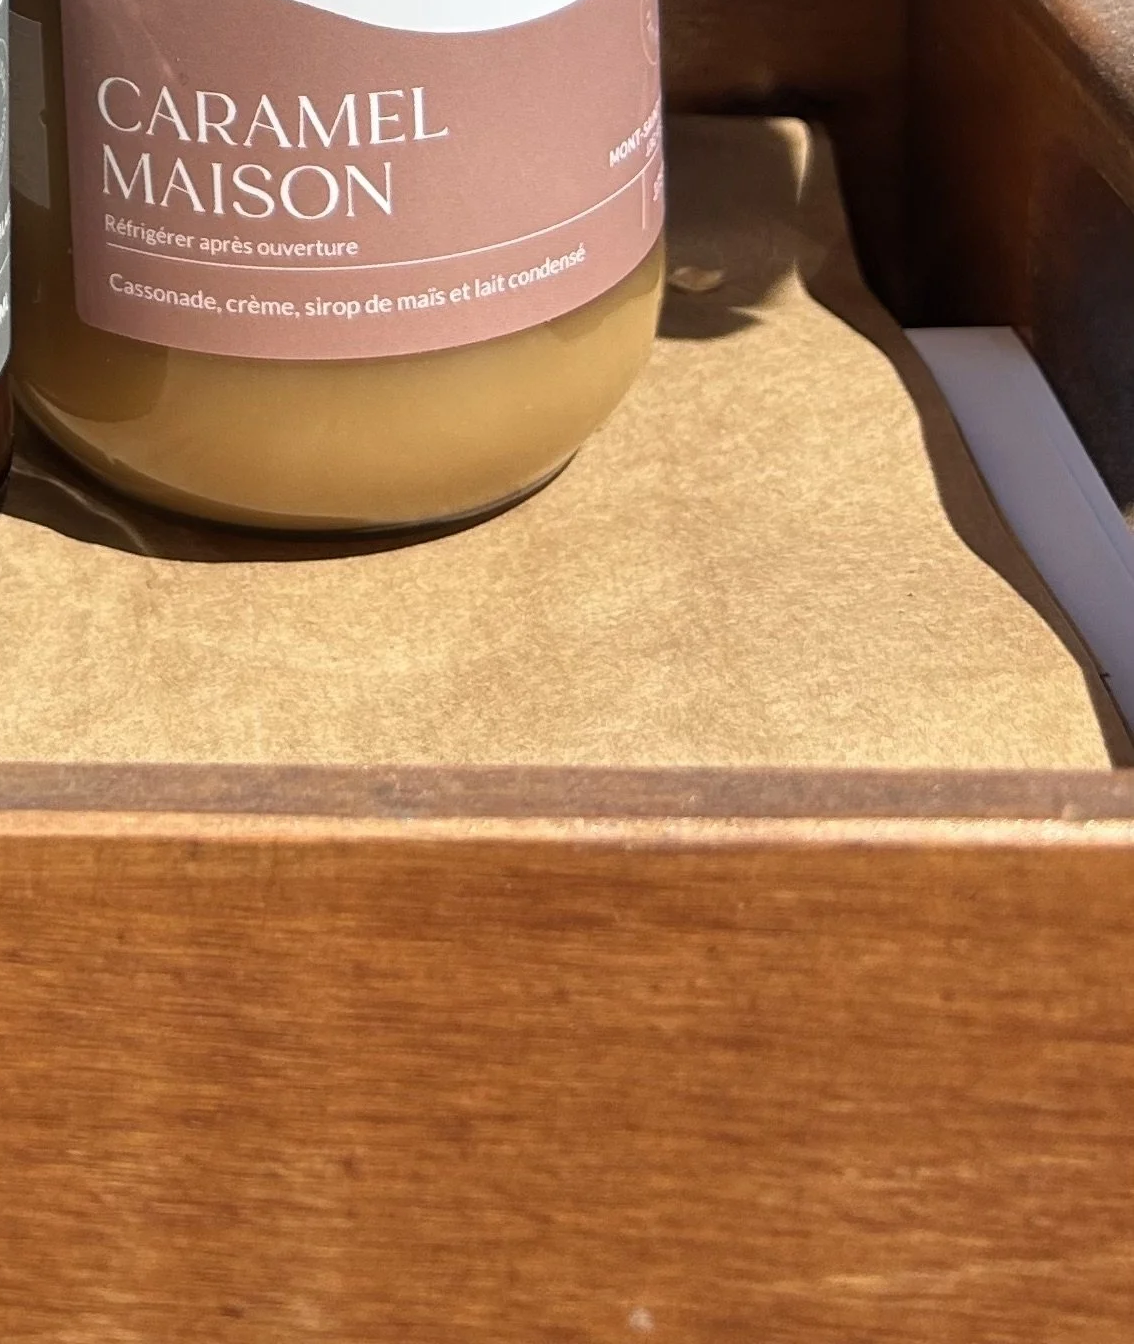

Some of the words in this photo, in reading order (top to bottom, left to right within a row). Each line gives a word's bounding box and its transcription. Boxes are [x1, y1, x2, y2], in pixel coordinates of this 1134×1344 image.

[97, 76, 450, 149] CARAMEL
[102, 143, 393, 220] MAISON
[104, 214, 195, 248] Réfrigérer
[199, 236, 253, 256] après
[257, 239, 359, 257] ouverture
[109, 272, 223, 314] Cassonade,
[226, 295, 300, 318] crème,
[304, 297, 361, 320] sirop
[365, 294, 393, 314] de
[397, 288, 446, 311] maïs
[449, 283, 471, 303] et
[474, 275, 505, 298] lait
[508, 242, 587, 289] condensé
